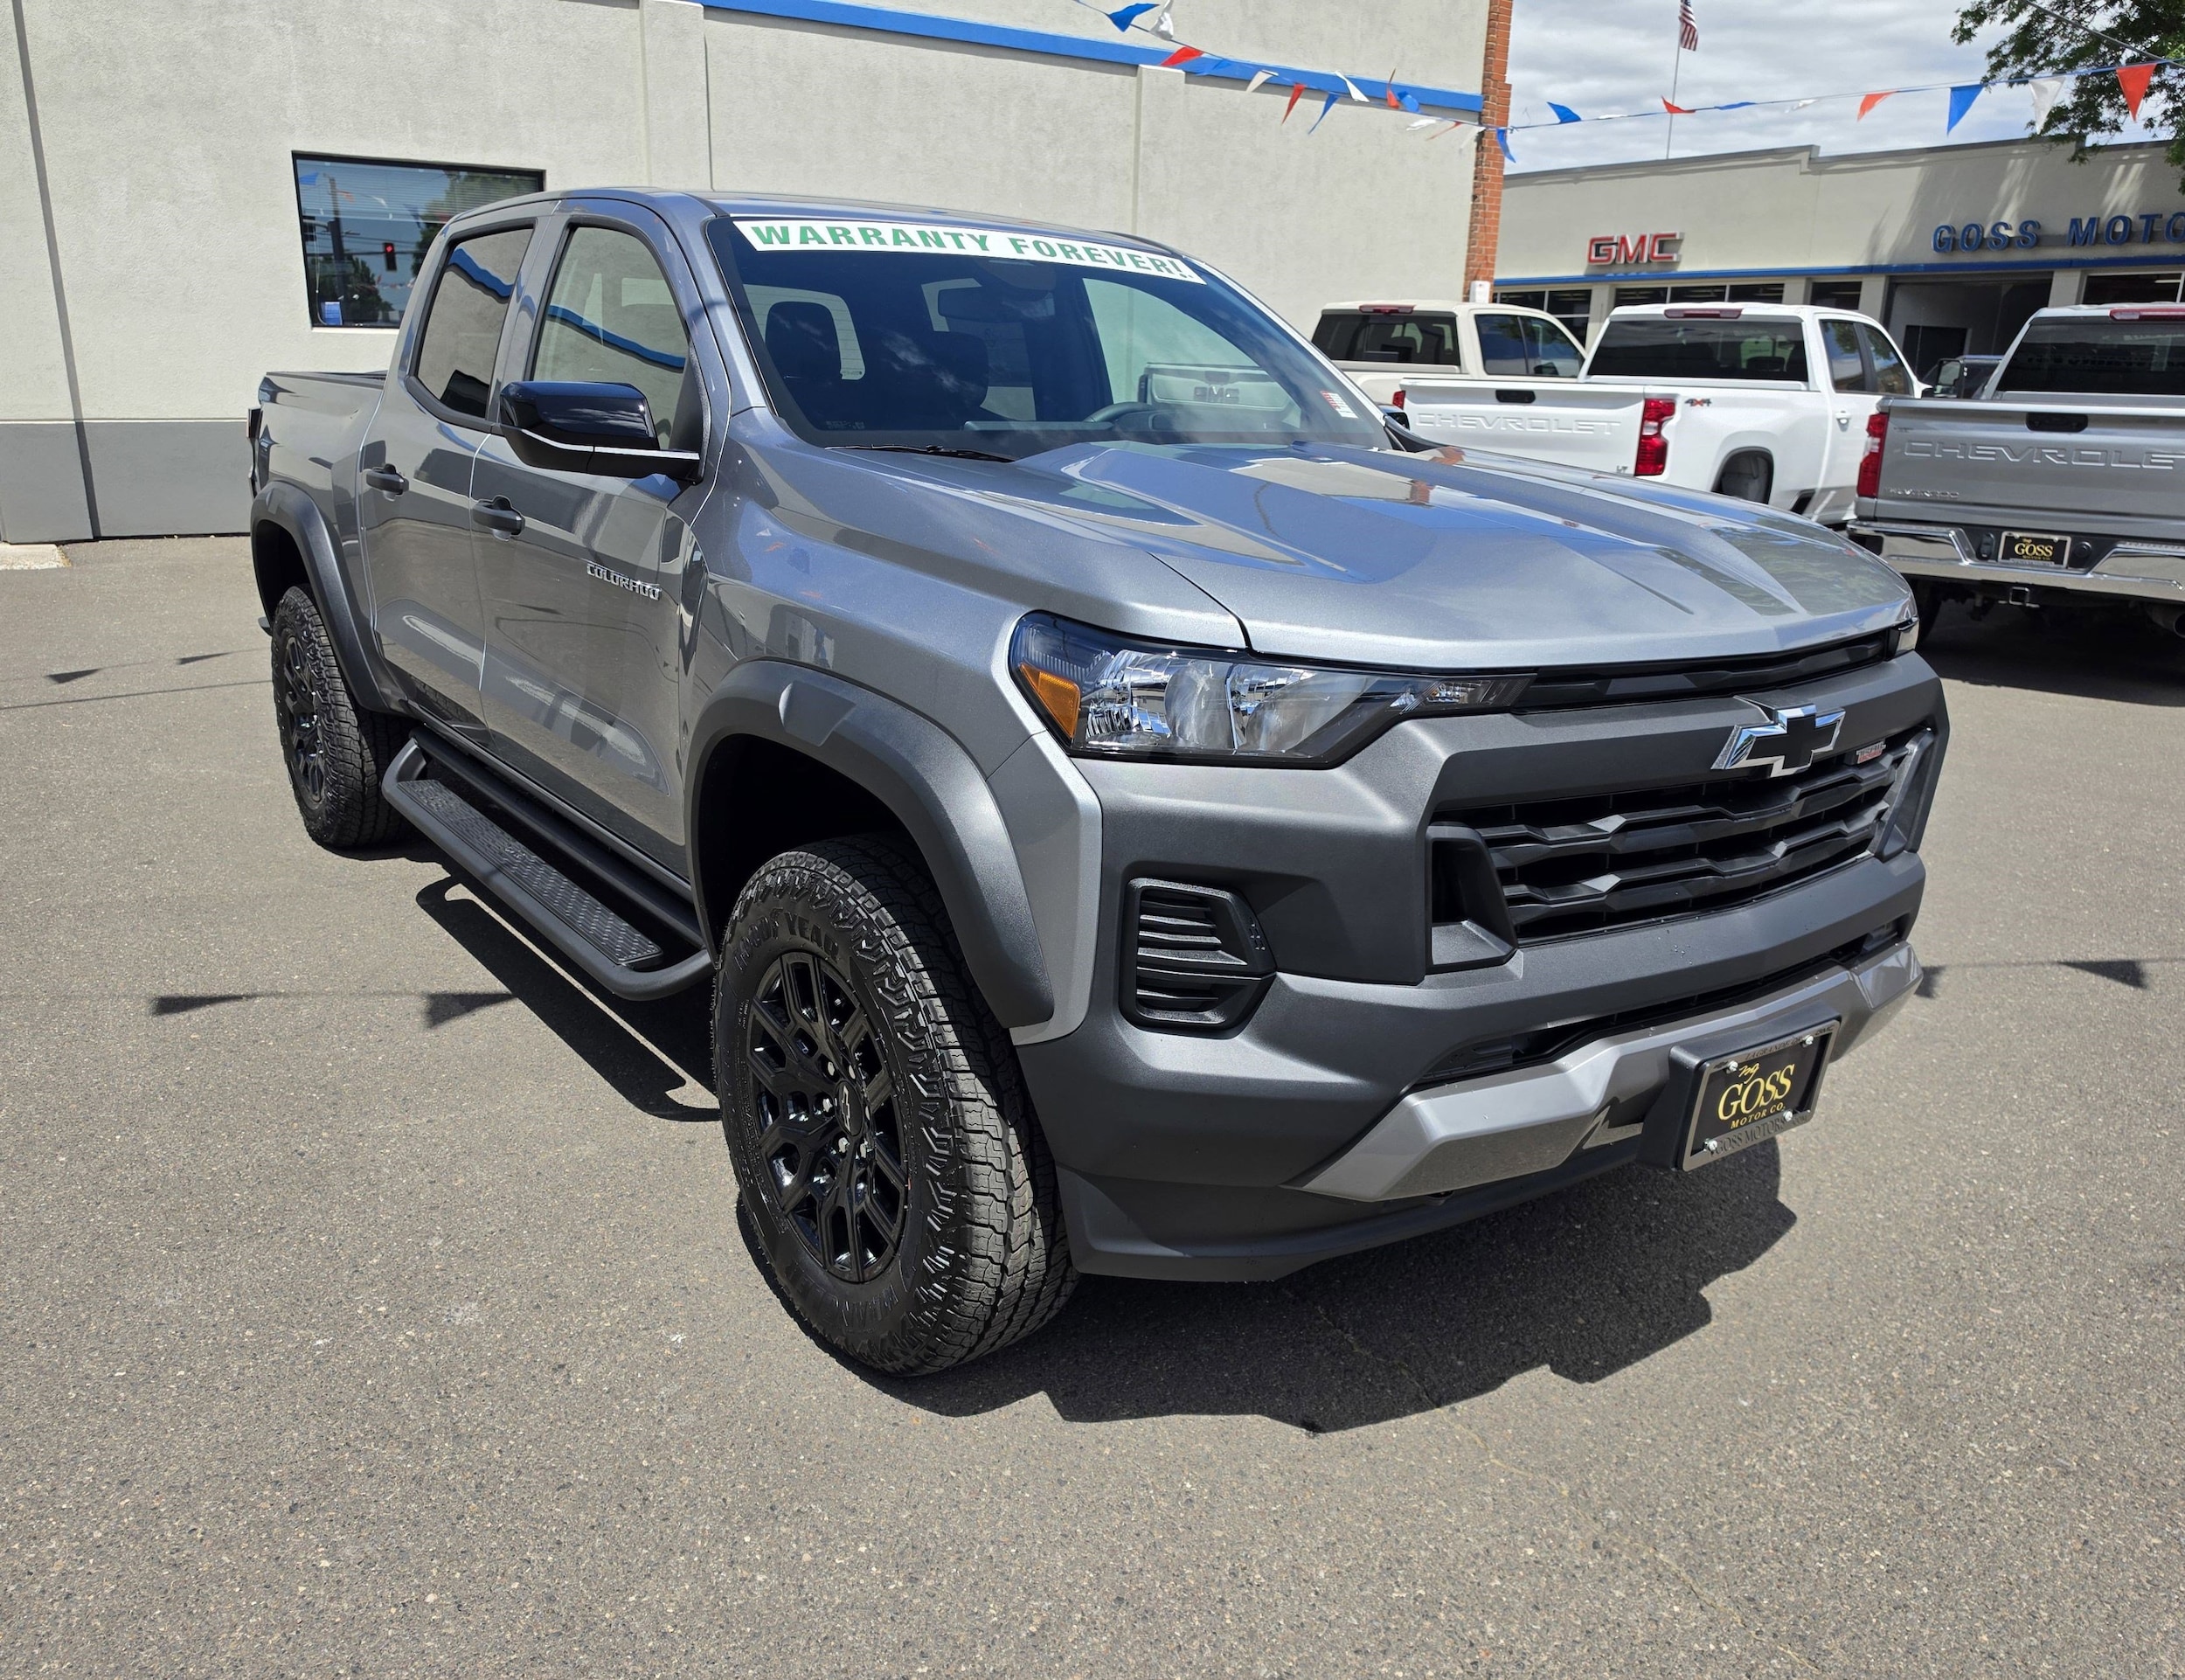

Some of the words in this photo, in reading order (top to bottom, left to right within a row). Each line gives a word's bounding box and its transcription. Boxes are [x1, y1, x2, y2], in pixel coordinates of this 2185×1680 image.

[1587, 232, 1679, 265] GMC
[1932, 219, 2041, 253] GOSS
[2066, 212, 2185, 246] MOTO
[751, 225, 989, 252] WARRANTY
[1008, 237, 1189, 279] FOREVER!
[1416, 413, 1621, 435] CHEVROLET
[2014, 543, 2054, 557] GOSS
[586, 562, 662, 600] COLORADO
[1717, 1063, 1795, 1121] GOSS
[1731, 1108, 1767, 1129] MOTOR
